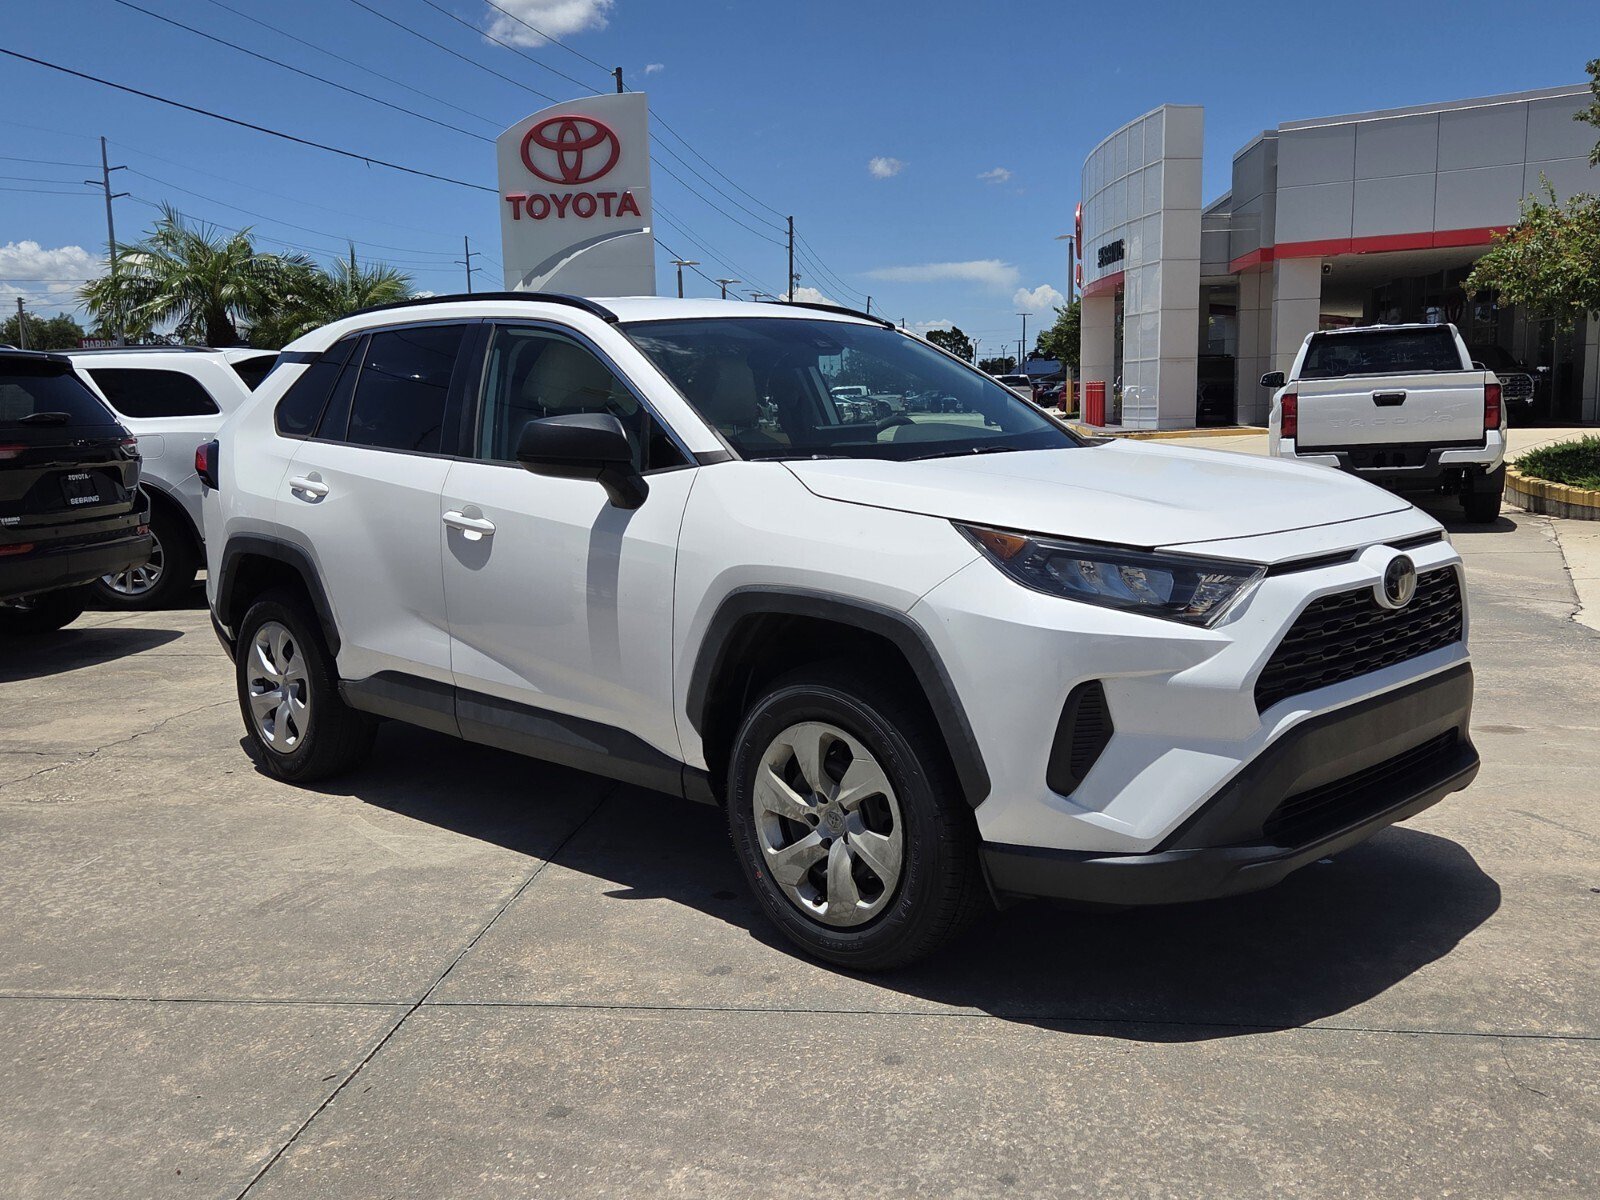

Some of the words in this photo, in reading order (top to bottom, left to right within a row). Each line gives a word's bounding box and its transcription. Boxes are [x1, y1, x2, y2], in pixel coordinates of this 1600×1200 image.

[506, 191, 641, 220] TOYOTA
[67, 473, 90, 481] TOYOTA
[70, 495, 100, 505] SEBRING
